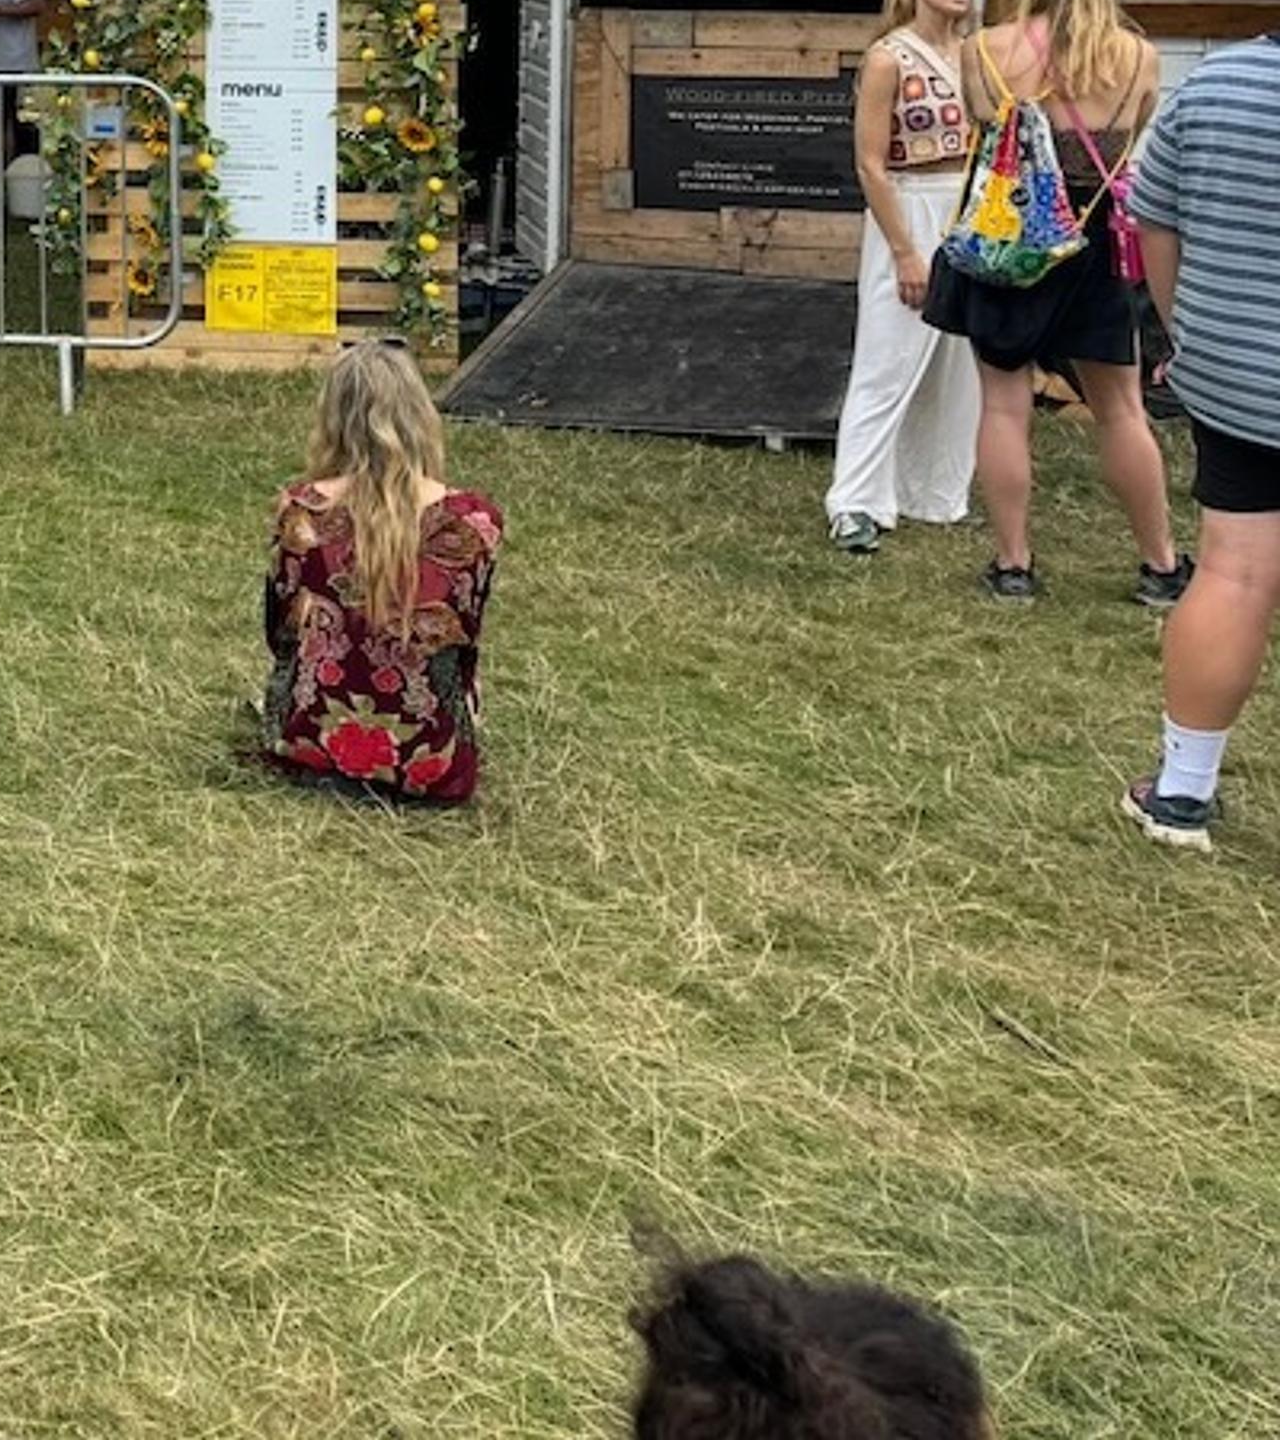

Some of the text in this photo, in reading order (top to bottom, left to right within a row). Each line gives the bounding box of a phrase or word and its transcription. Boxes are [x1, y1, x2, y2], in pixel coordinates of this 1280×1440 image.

[221, 82, 283, 97] menu
[802, 90, 852, 107] PIZZ
[217, 283, 258, 302] F17
